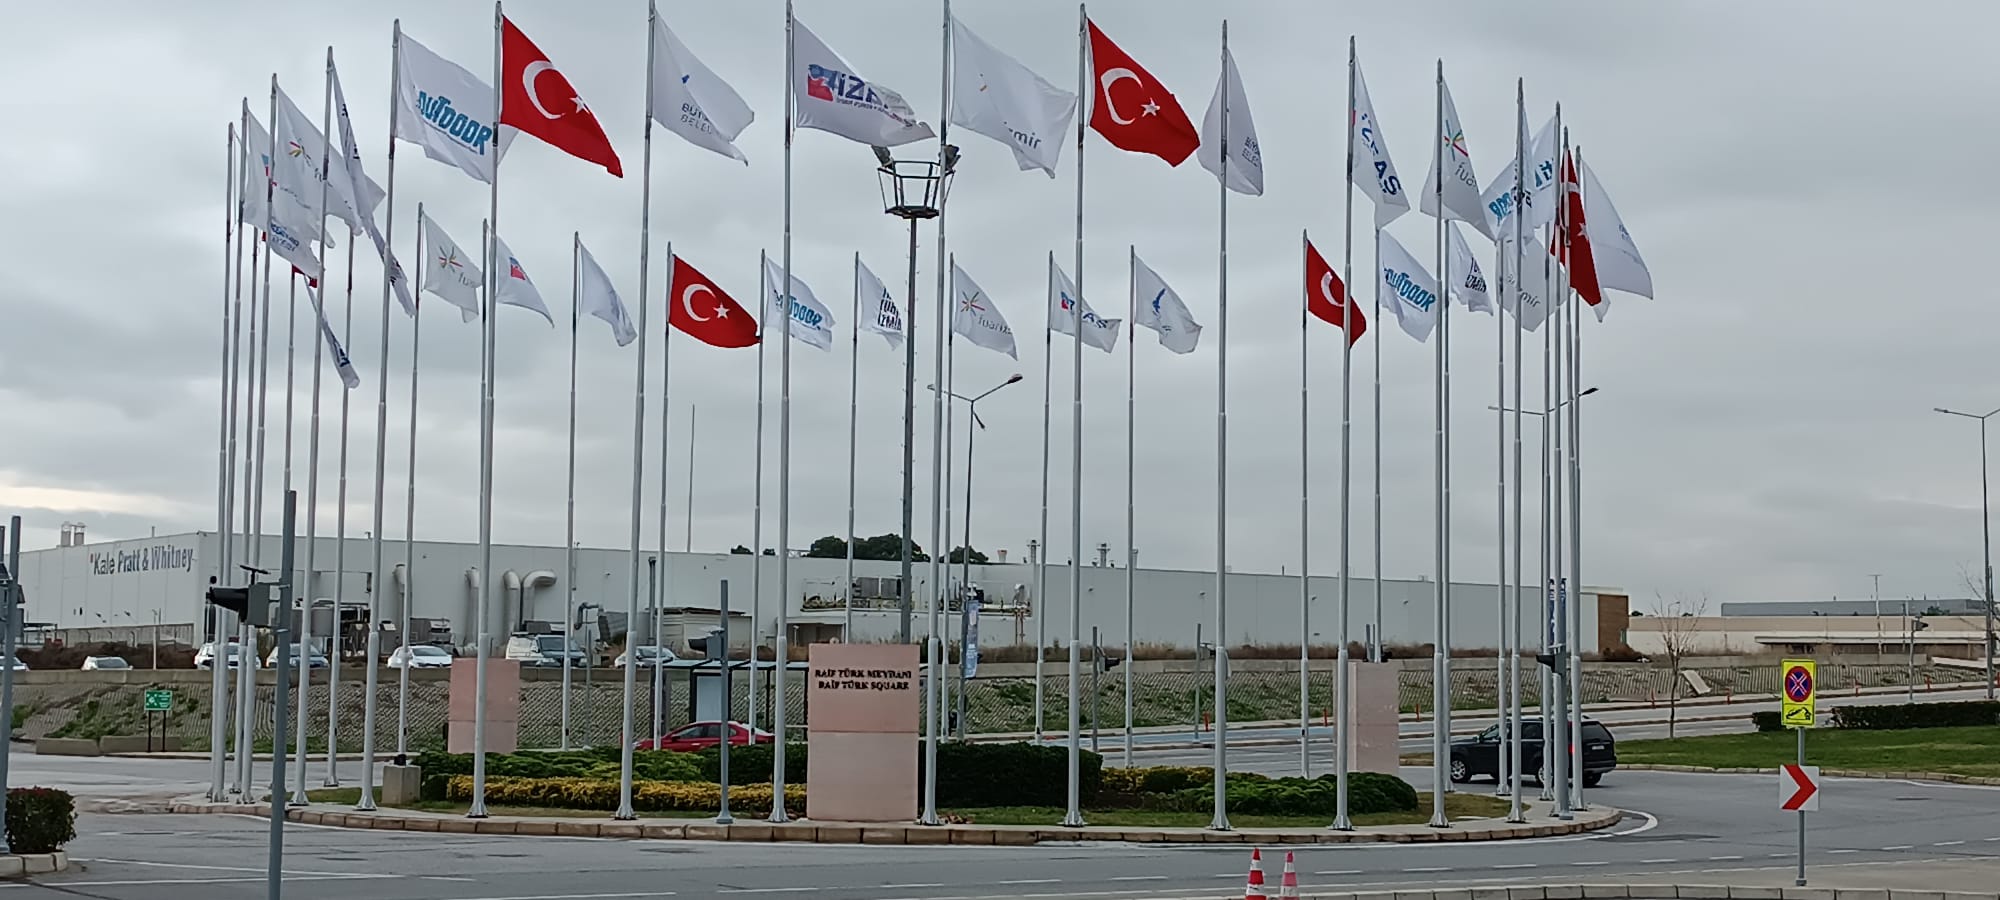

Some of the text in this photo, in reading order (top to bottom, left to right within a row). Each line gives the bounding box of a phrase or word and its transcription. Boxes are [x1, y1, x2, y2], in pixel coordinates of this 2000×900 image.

[93, 545, 194, 575] Kale Pratt & Whitney
